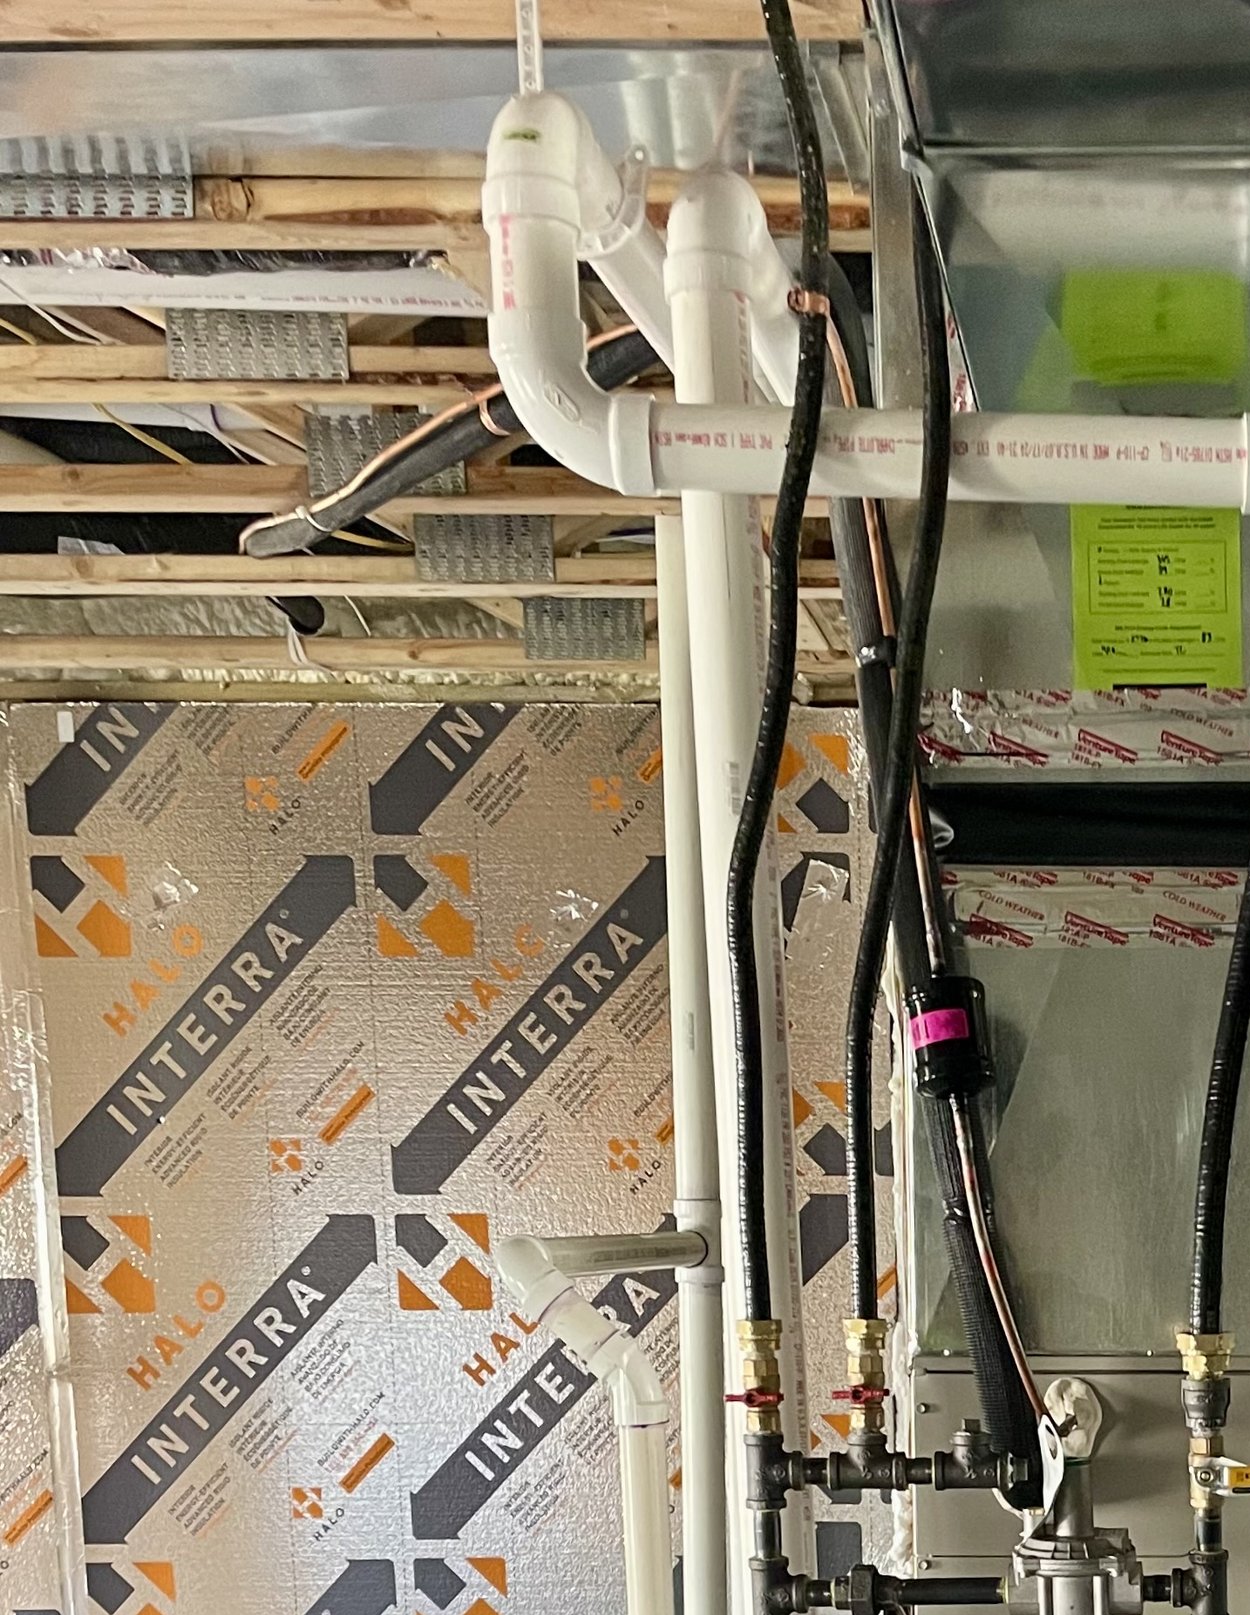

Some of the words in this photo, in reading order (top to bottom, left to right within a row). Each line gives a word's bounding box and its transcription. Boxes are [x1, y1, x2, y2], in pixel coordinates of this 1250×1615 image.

[80, 702, 160, 772] IN
[425, 702, 505, 772] IN
[1170, 708, 1195, 722] COLD
[1195, 714, 1234, 737] WEATHER
[268, 799, 302, 837] HALO
[611, 799, 646, 837] HALO
[978, 890, 1002, 906] COLD
[1004, 900, 1045, 921] WEATHER
[1162, 890, 1187, 908] COLD
[1188, 902, 1228, 922] WEATHER
[1153, 917, 1215, 948] VentureTape
[103, 924, 203, 1038] HALO
[107, 922, 304, 1135] INTERRA
[447, 922, 643, 1134] INTERRA
[291, 1160, 325, 1196] HALO
[629, 1159, 662, 1195] HALO
[127, 1280, 225, 1392] HALO
[131, 1279, 327, 1484] INTERRA
[465, 1277, 660, 1481] INTERA
[312, 1507, 345, 1542] HALO
